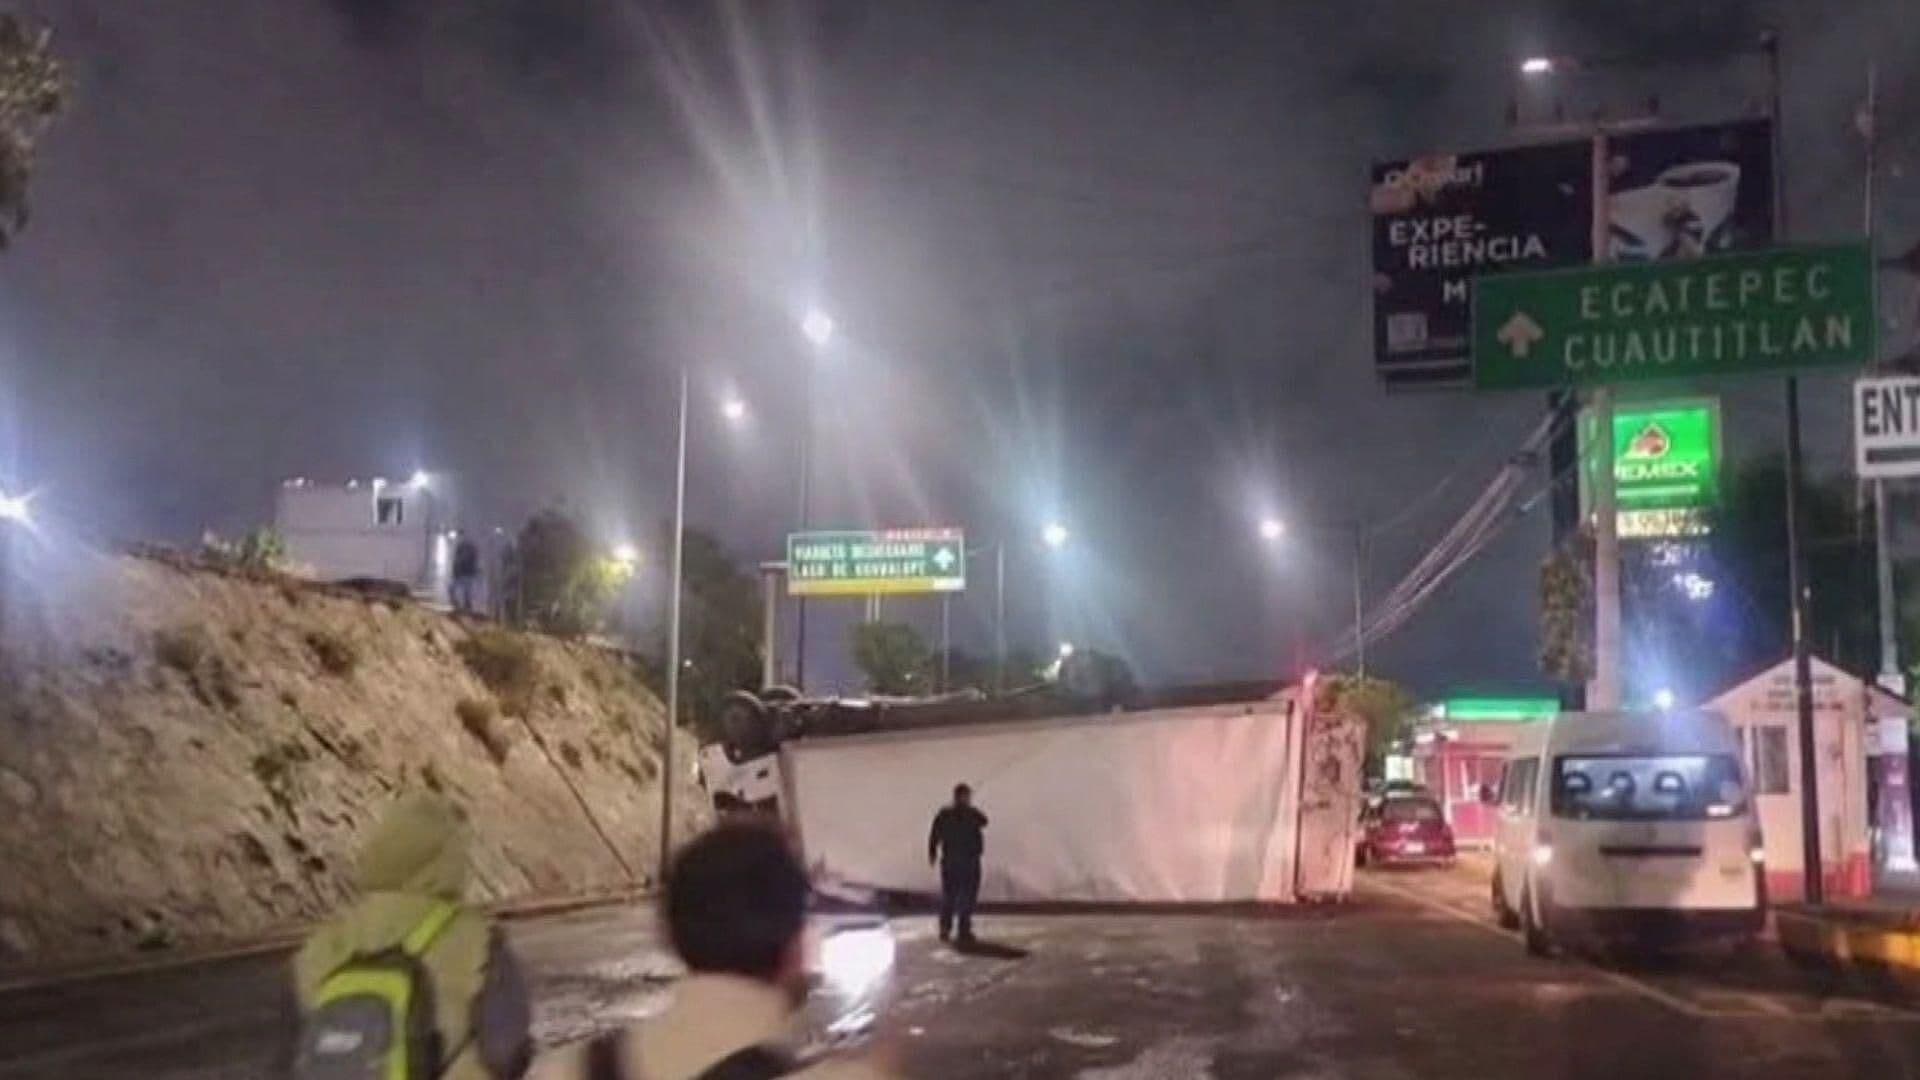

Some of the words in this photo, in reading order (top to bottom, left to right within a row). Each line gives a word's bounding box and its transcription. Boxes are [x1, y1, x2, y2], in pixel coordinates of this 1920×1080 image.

[1389, 214, 1487, 246] EXPE-
[1407, 235, 1547, 269] RIENCIA
[1580, 264, 1830, 320] ECATEPEC
[1564, 315, 1851, 369] CUAUTITLAN
